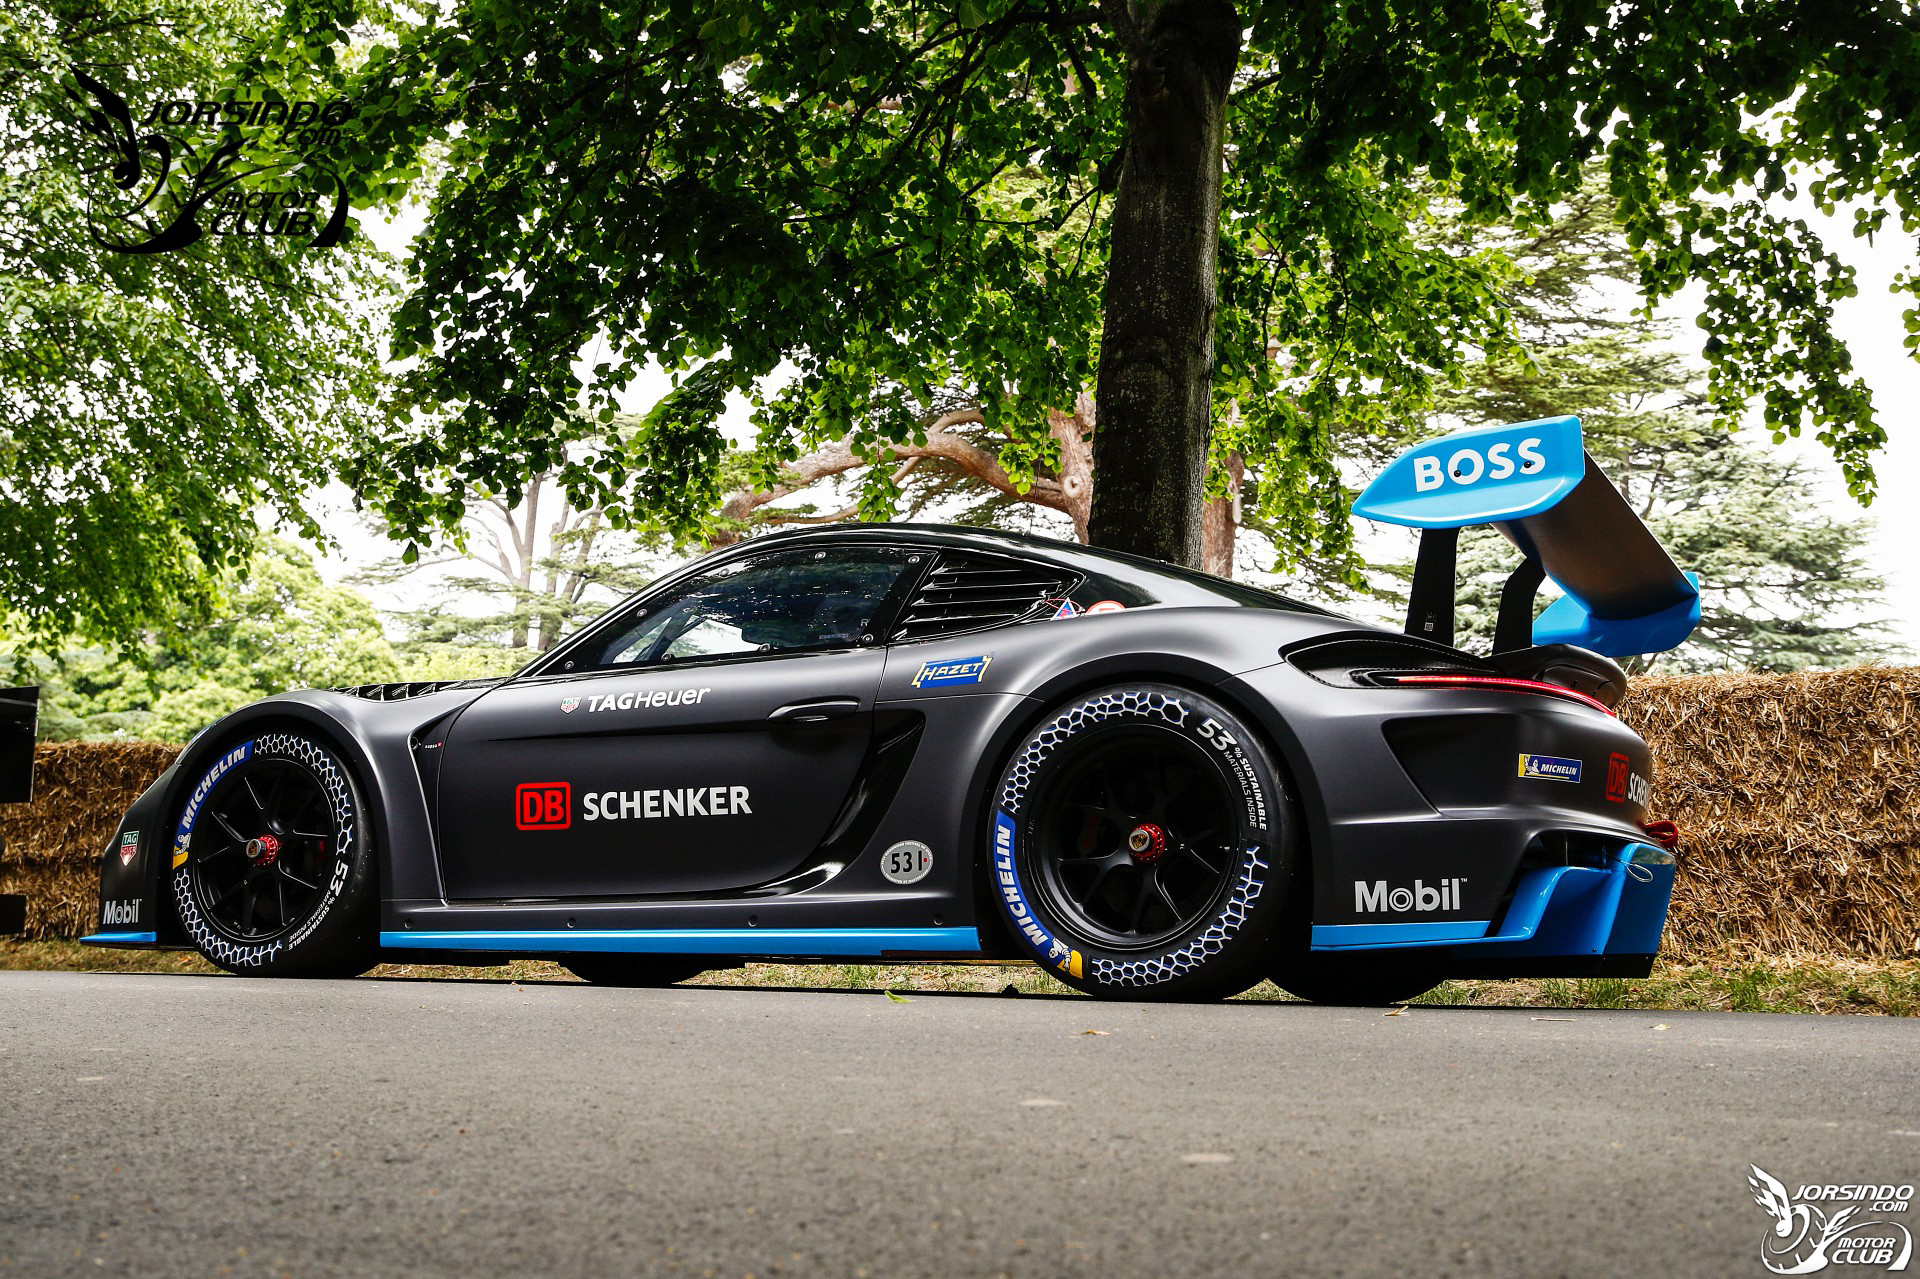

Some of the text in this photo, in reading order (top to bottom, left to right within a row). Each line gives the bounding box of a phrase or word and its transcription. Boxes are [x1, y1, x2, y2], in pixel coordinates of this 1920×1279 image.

[1413, 438, 1546, 493] BOSS
[920, 662, 983, 681] HAZET
[182, 746, 246, 830] MICHELIN
[1223, 750, 1257, 828] MATERIALS INSIDE
[1540, 763, 1578, 775] MICHELIN
[523, 785, 752, 823] DB SCHENKER
[1239, 757, 1267, 831] SUSTAINABLE
[123, 833, 137, 845] TAG
[890, 850, 923, 874] 531
[996, 824, 1048, 946] MICHELIN
[288, 905, 330, 950] SUSTAINABLE
[306, 890, 331, 927] MATERIALS
